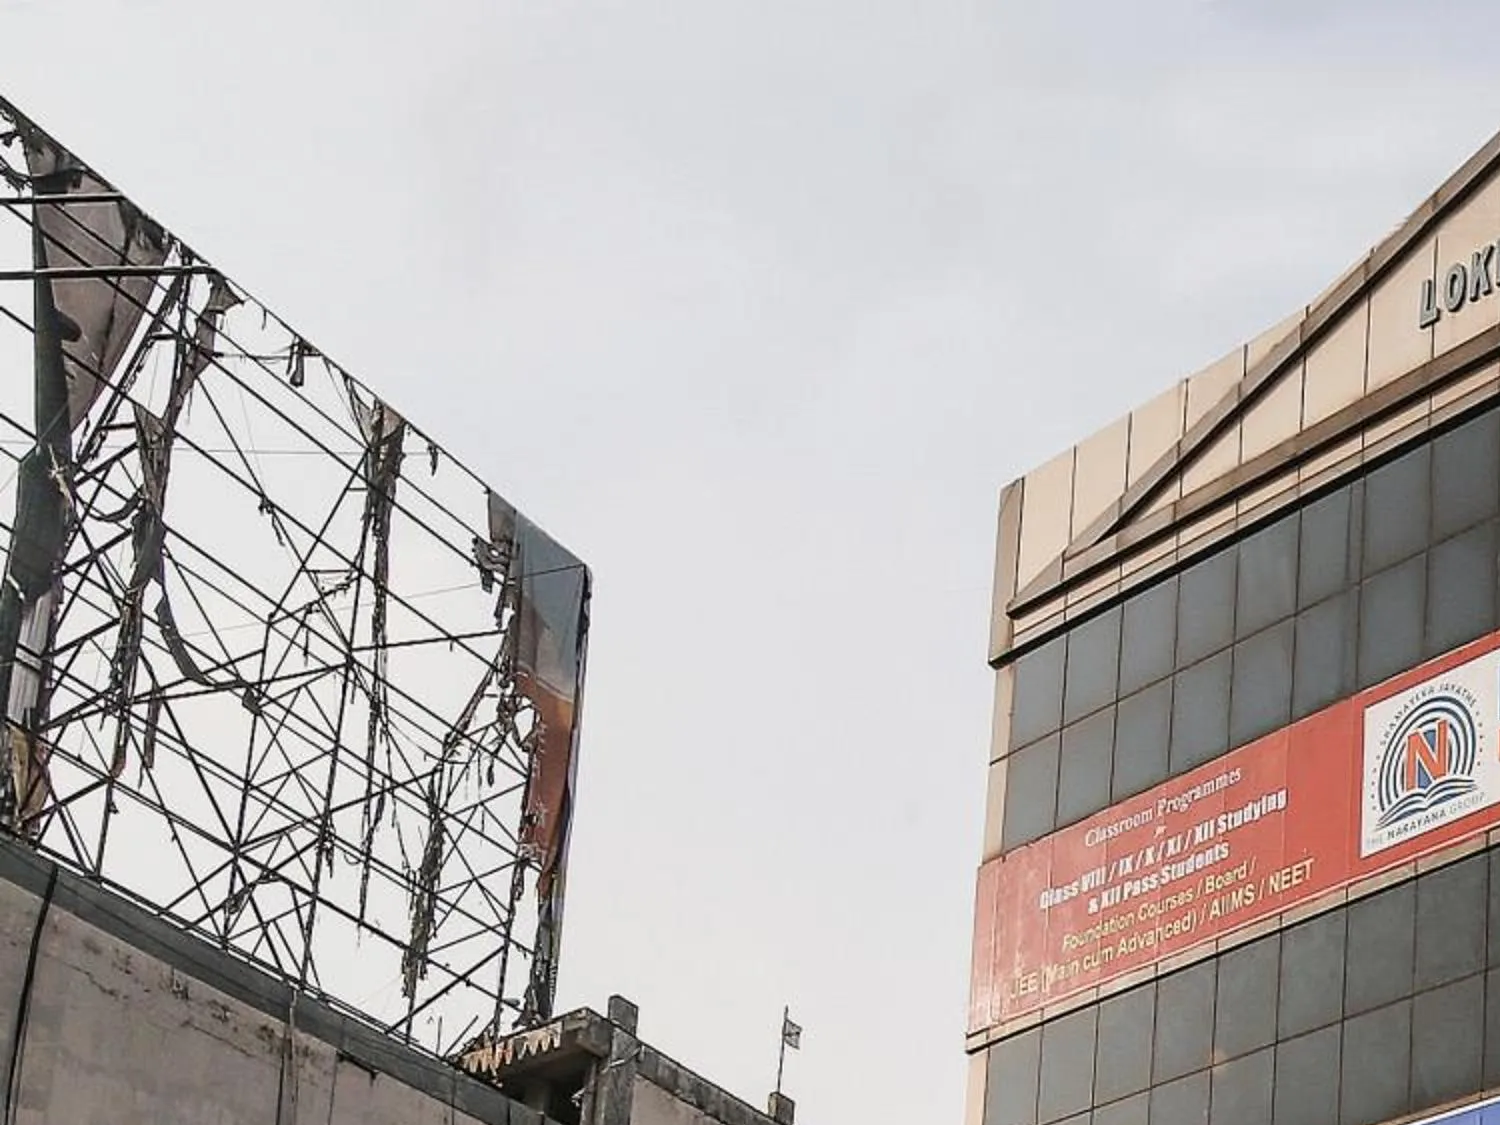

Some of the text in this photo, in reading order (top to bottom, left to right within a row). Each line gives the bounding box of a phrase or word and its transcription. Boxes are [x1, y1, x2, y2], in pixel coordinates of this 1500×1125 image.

[1084, 768, 1241, 847] Classroom Programmes
[1217, 788, 1289, 836] Studying
[1161, 841, 1230, 884] Students
[1062, 913, 1135, 952] Foundation
[1138, 887, 1194, 921] Courses
[1205, 860, 1247, 893] Board
[1083, 945, 1113, 970] cum
[1116, 910, 1197, 958] Advanced)
[1209, 883, 1255, 921] AIIMS
[1268, 858, 1315, 895] NEET
